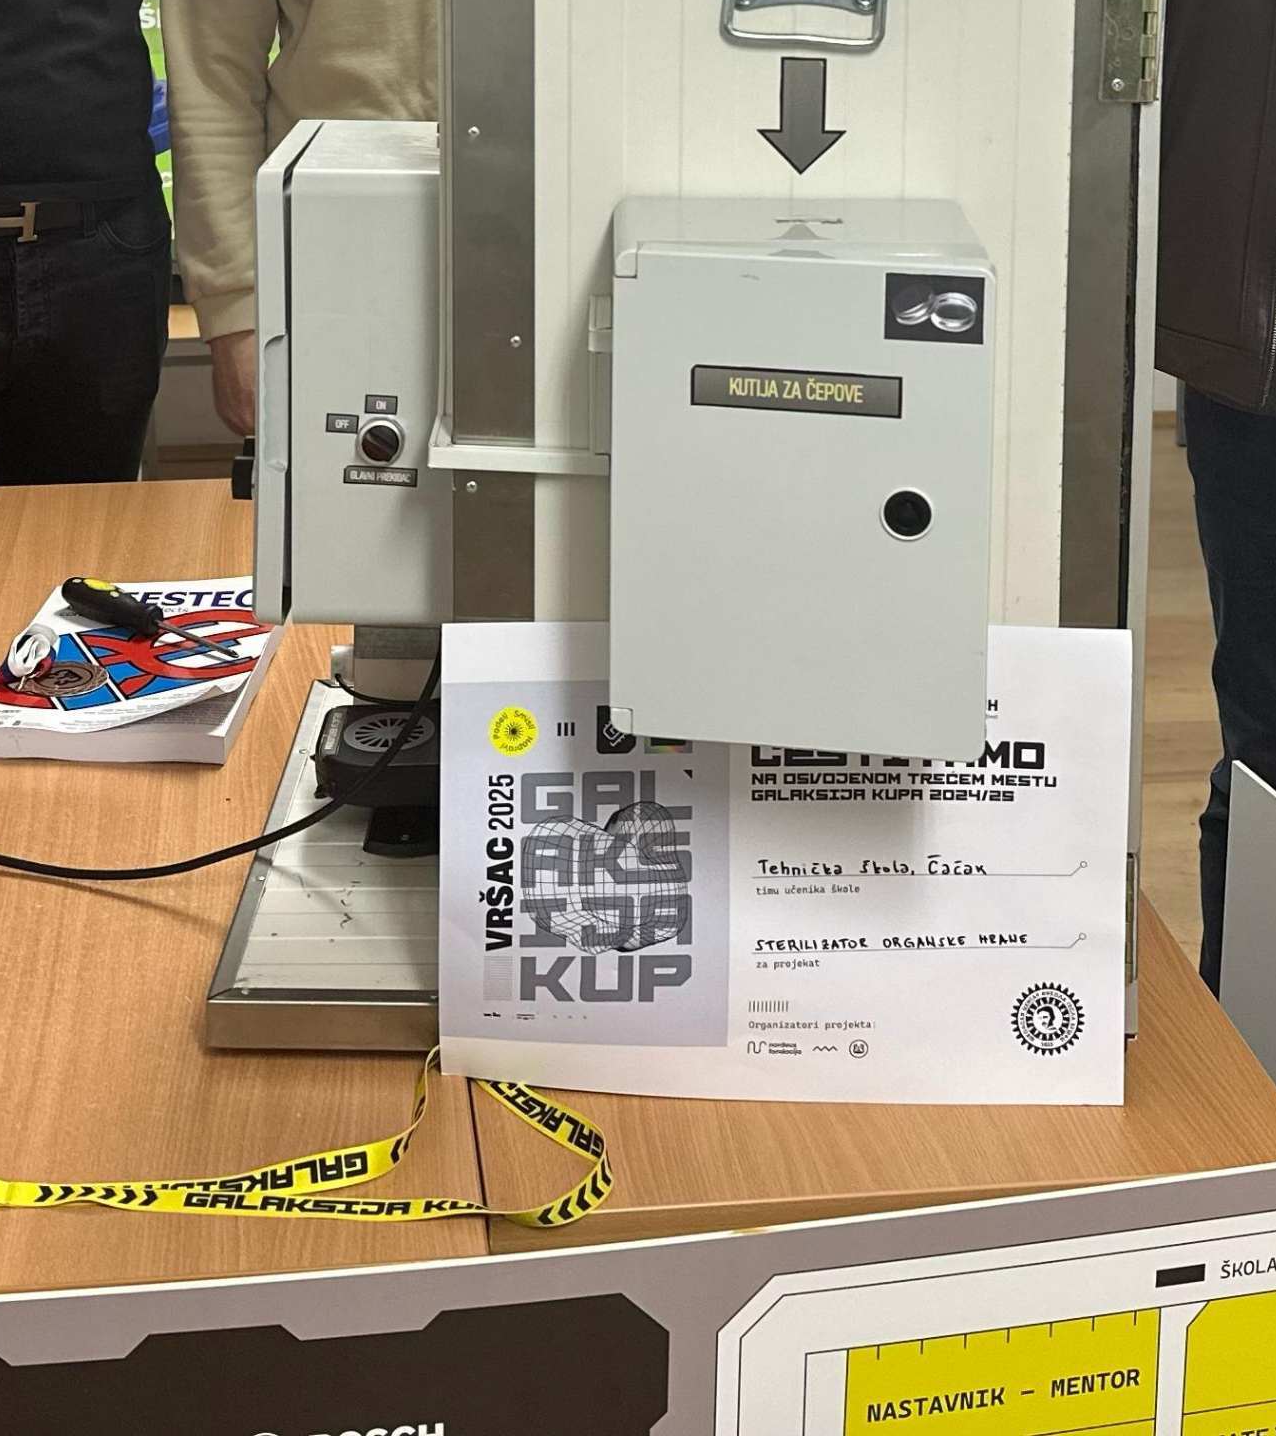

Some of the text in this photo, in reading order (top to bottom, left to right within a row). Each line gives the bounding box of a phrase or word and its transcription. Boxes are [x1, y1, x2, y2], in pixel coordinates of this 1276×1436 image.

[729, 377, 864, 404] KUTIJA ZA ČEPOVE
[375, 400, 387, 410] ON
[335, 419, 350, 429] OFF
[751, 773, 777, 785] NA
[783, 772, 901, 786] OSVOJENOM
[991, 774, 1057, 788] MESTU
[751, 788, 1015, 802] GALAKSIJA KUPA 2024/25
[479, 773, 515, 952] VRŠAC 2025
[756, 885, 780, 896] timu
[784, 884, 826, 895] učenika
[755, 933, 1028, 952] STERILIZATOR ORGANSKE HRANE
[756, 958, 820, 970] za projekat
[519, 954, 692, 1003] KUP
[748, 1019, 819, 1031] Organizatori
[184, 1192, 411, 1216] GALAKSIJA
[867, 1387, 1006, 1423] NASTAVNIK
[1050, 1368, 1141, 1398] MENTOR
